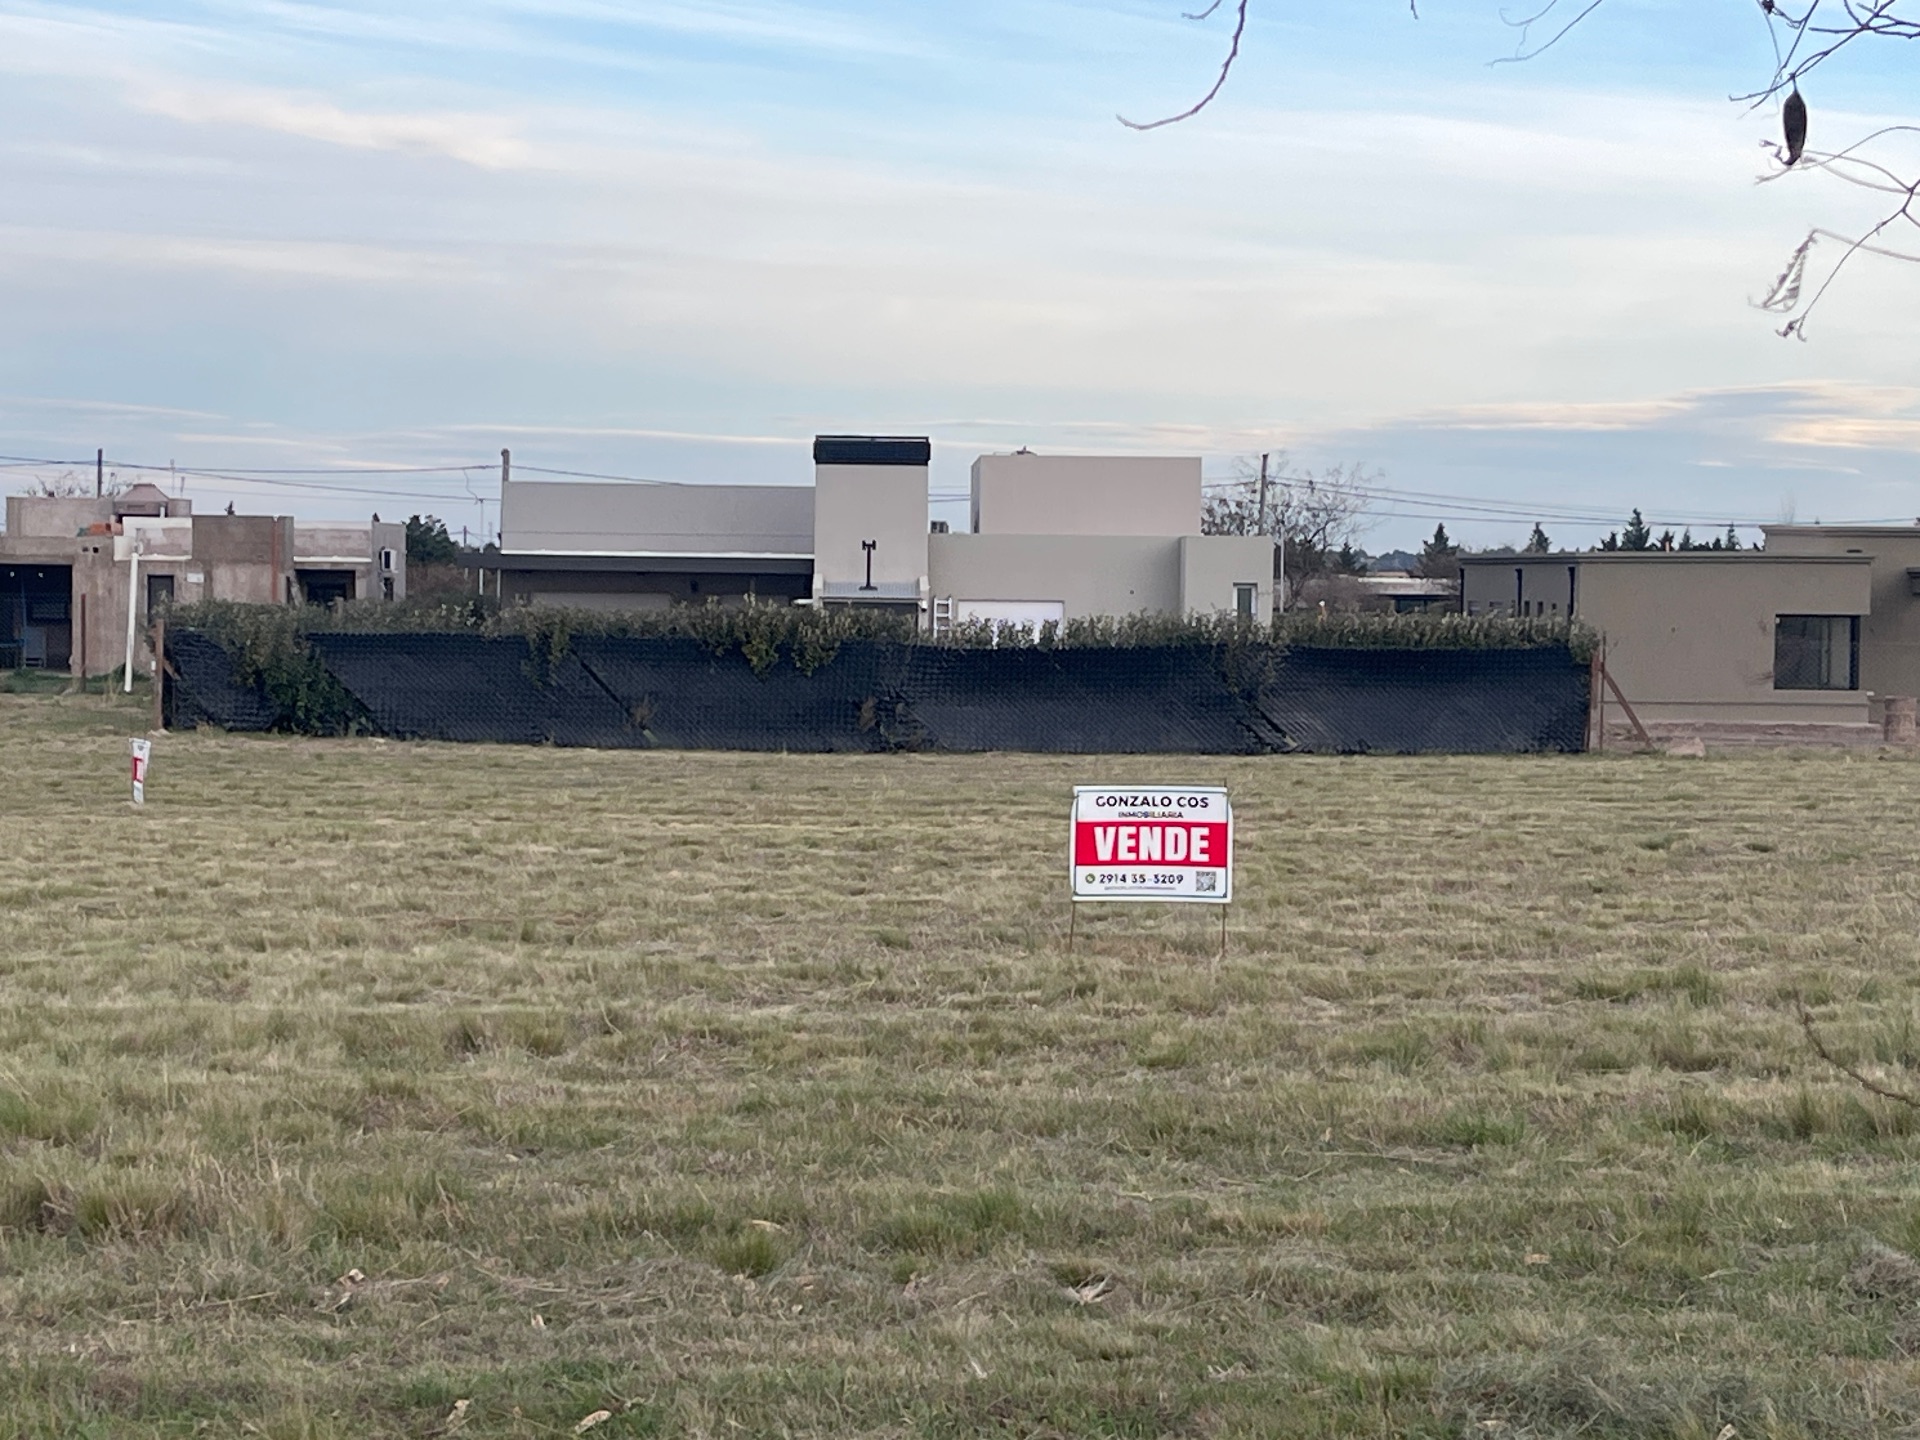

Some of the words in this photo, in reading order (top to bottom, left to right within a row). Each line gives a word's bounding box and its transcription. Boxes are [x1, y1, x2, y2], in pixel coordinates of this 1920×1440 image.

[1096, 795, 1172, 808] GONZALO
[1177, 796, 1210, 809] COS
[1093, 825, 1210, 863] VENDE
[1098, 873, 1127, 885] 2914
